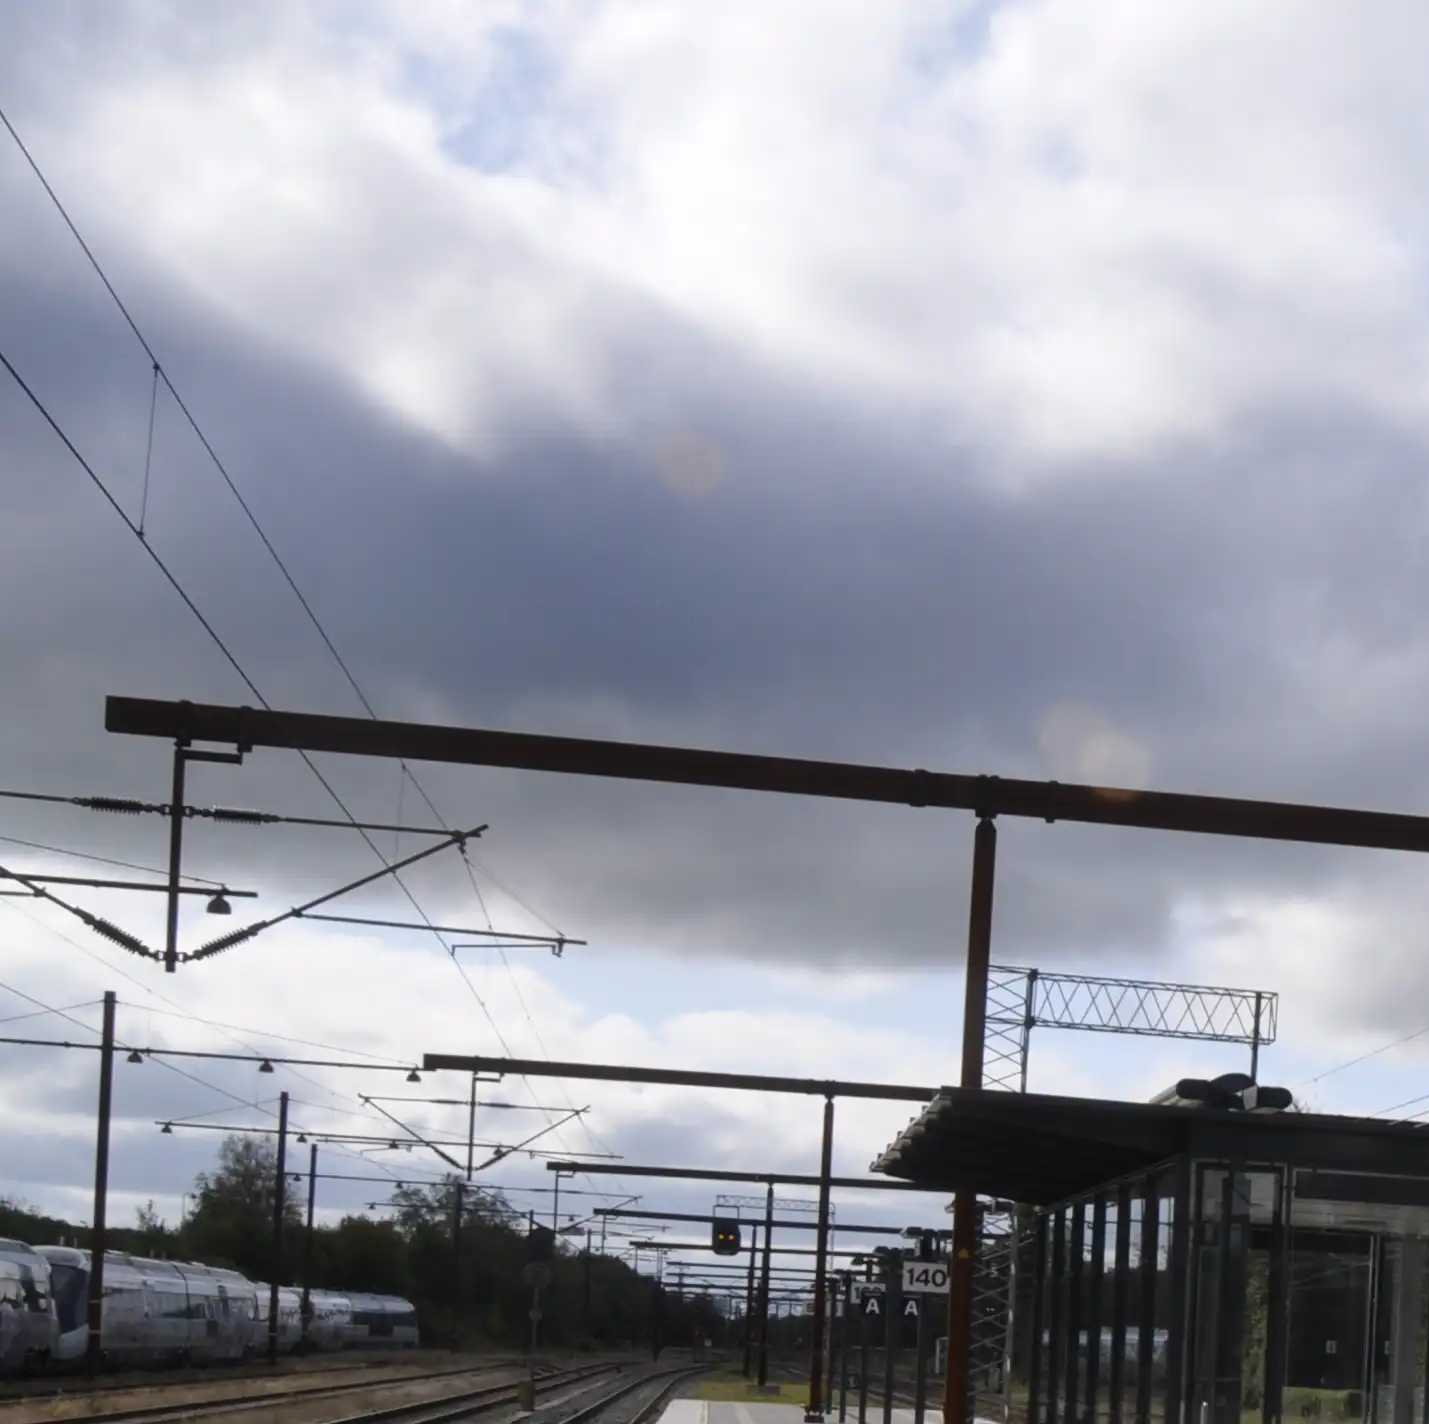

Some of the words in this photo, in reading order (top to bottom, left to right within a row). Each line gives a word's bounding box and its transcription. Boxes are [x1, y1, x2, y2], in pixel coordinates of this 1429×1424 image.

[906, 1267, 947, 1287] 140
[865, 1298, 880, 1314] A
[904, 1300, 919, 1316] A
